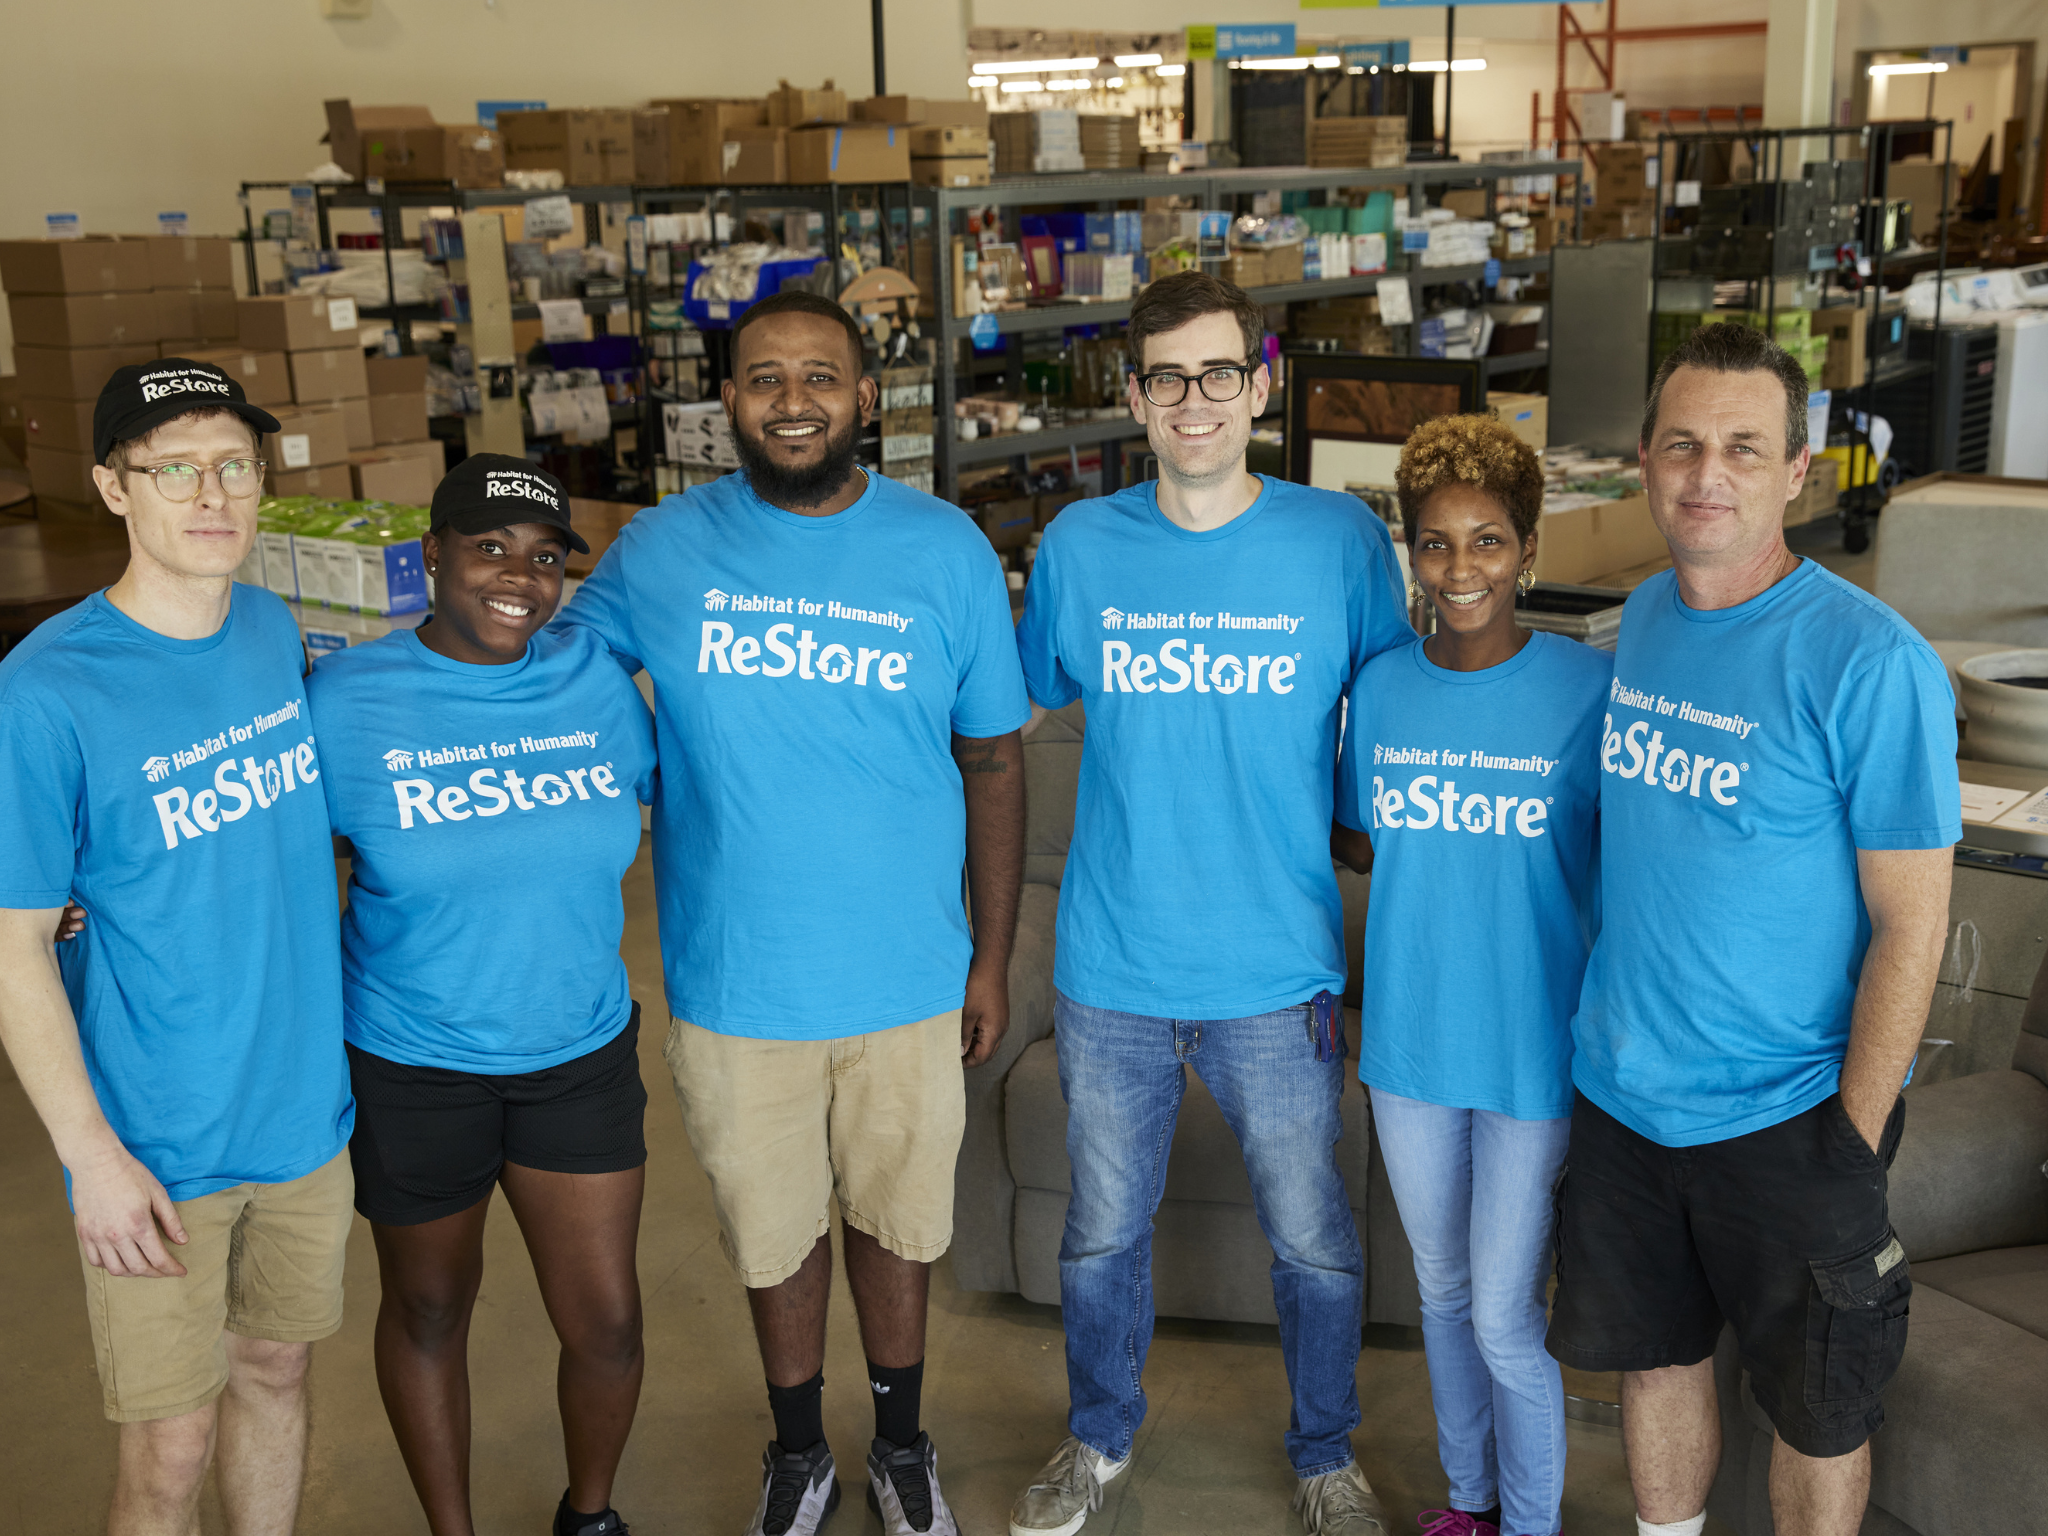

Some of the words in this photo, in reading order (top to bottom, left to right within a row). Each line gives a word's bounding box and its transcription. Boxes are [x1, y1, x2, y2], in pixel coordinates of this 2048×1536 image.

[149, 370, 178, 380] Habitat
[178, 369, 190, 377] for
[497, 470, 522, 479] Habitat
[522, 472, 533, 482] for
[731, 594, 794, 614] Habitat
[797, 597, 824, 616] for
[1126, 612, 1185, 630] Habitat
[1189, 611, 1214, 629] for
[1616, 685, 1655, 712] Habitat
[1655, 695, 1678, 717] for
[171, 731, 229, 772] Habitat
[228, 725, 253, 745] for
[417, 744, 488, 768] Habitat
[490, 741, 517, 759] for
[1383, 747, 1439, 766] Habitat
[1441, 749, 1467, 767] for
